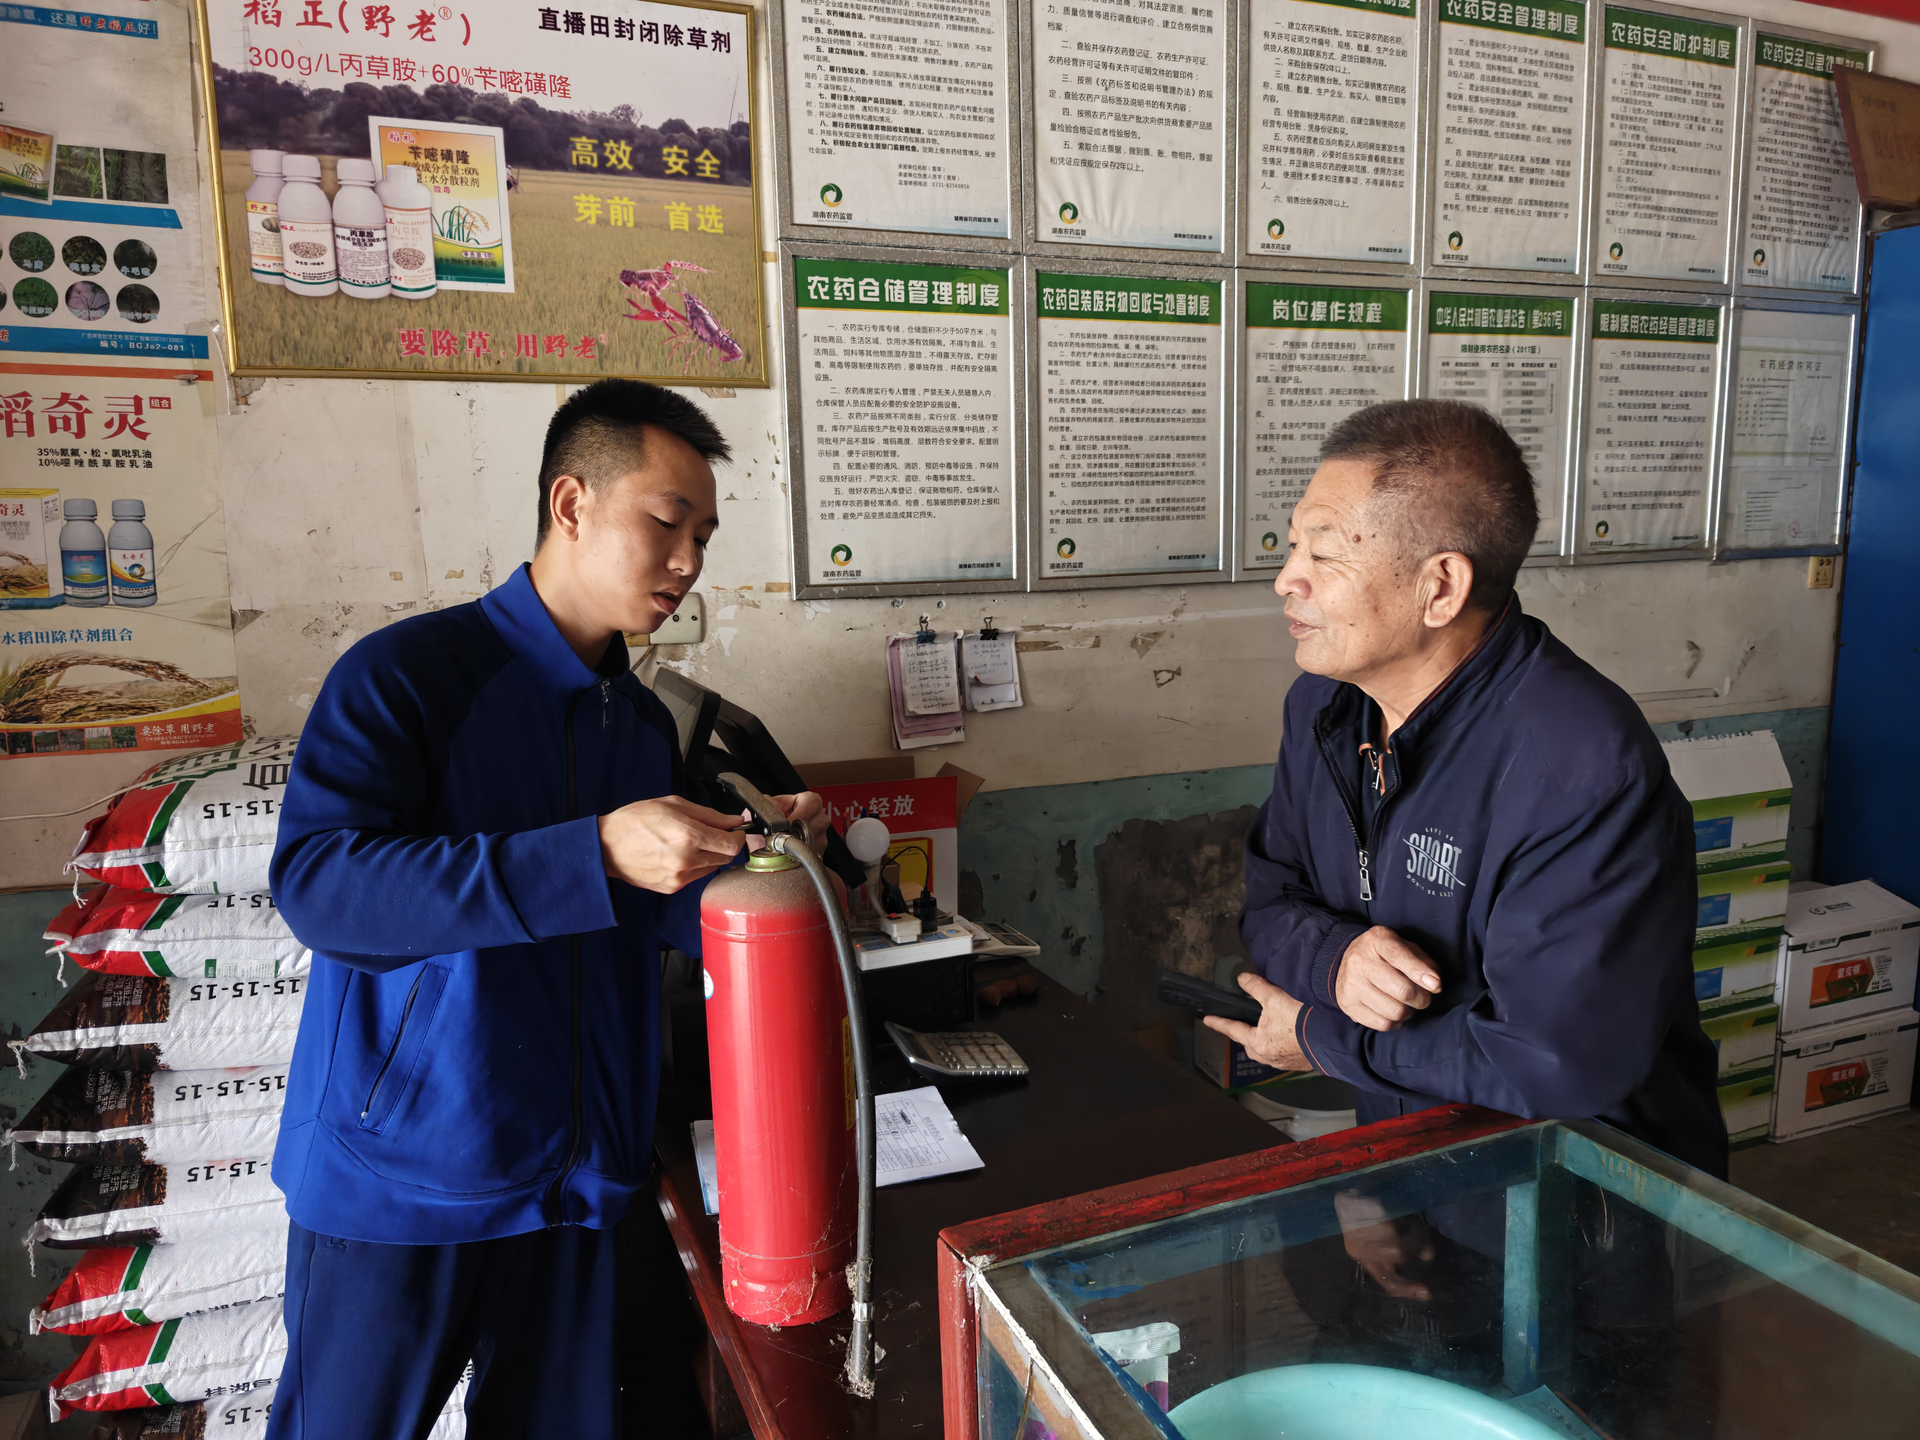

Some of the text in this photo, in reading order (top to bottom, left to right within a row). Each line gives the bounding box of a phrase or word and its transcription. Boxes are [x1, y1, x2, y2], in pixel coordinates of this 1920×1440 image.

[538, 7, 731, 53] 直播田封闭除草剂
[1447, 0, 1578, 35] 农药安全管理制度
[1611, 22, 1730, 59] 农药安全防护制度
[248, 47, 572, 99] 300g/L丙草胺+60%苄嘧磺隆
[408, 145, 470, 165] 苄嘧磺隆
[570, 136, 721, 179] 高效 安全
[573, 193, 724, 234] 芽前 首选
[812, 210, 853, 221] 湖南农药监管
[1051, 227, 1087, 237] 湖南农药监管
[807, 275, 1000, 307] 农药仓储管理制度
[1042, 287, 1210, 317] 农药包装废弃物回收与处置制度
[1273, 299, 1382, 323] 岗位操作规程
[1600, 313, 1715, 337] 限制使用农药经营管理制度
[1759, 359, 1822, 372] 农药经营许可证
[0, 390, 152, 441] 稻奇灵
[150, 398, 170, 408] 组合
[822, 569, 862, 578] 湖南农药监管
[1, 627, 133, 646] 水稻田除草剂组合
[822, 794, 915, 821] 小心轻放
[1406, 833, 1463, 890] SHORT
[190, 978, 301, 1001] 15-15-15
[174, 1075, 286, 1101] 15-15-15
